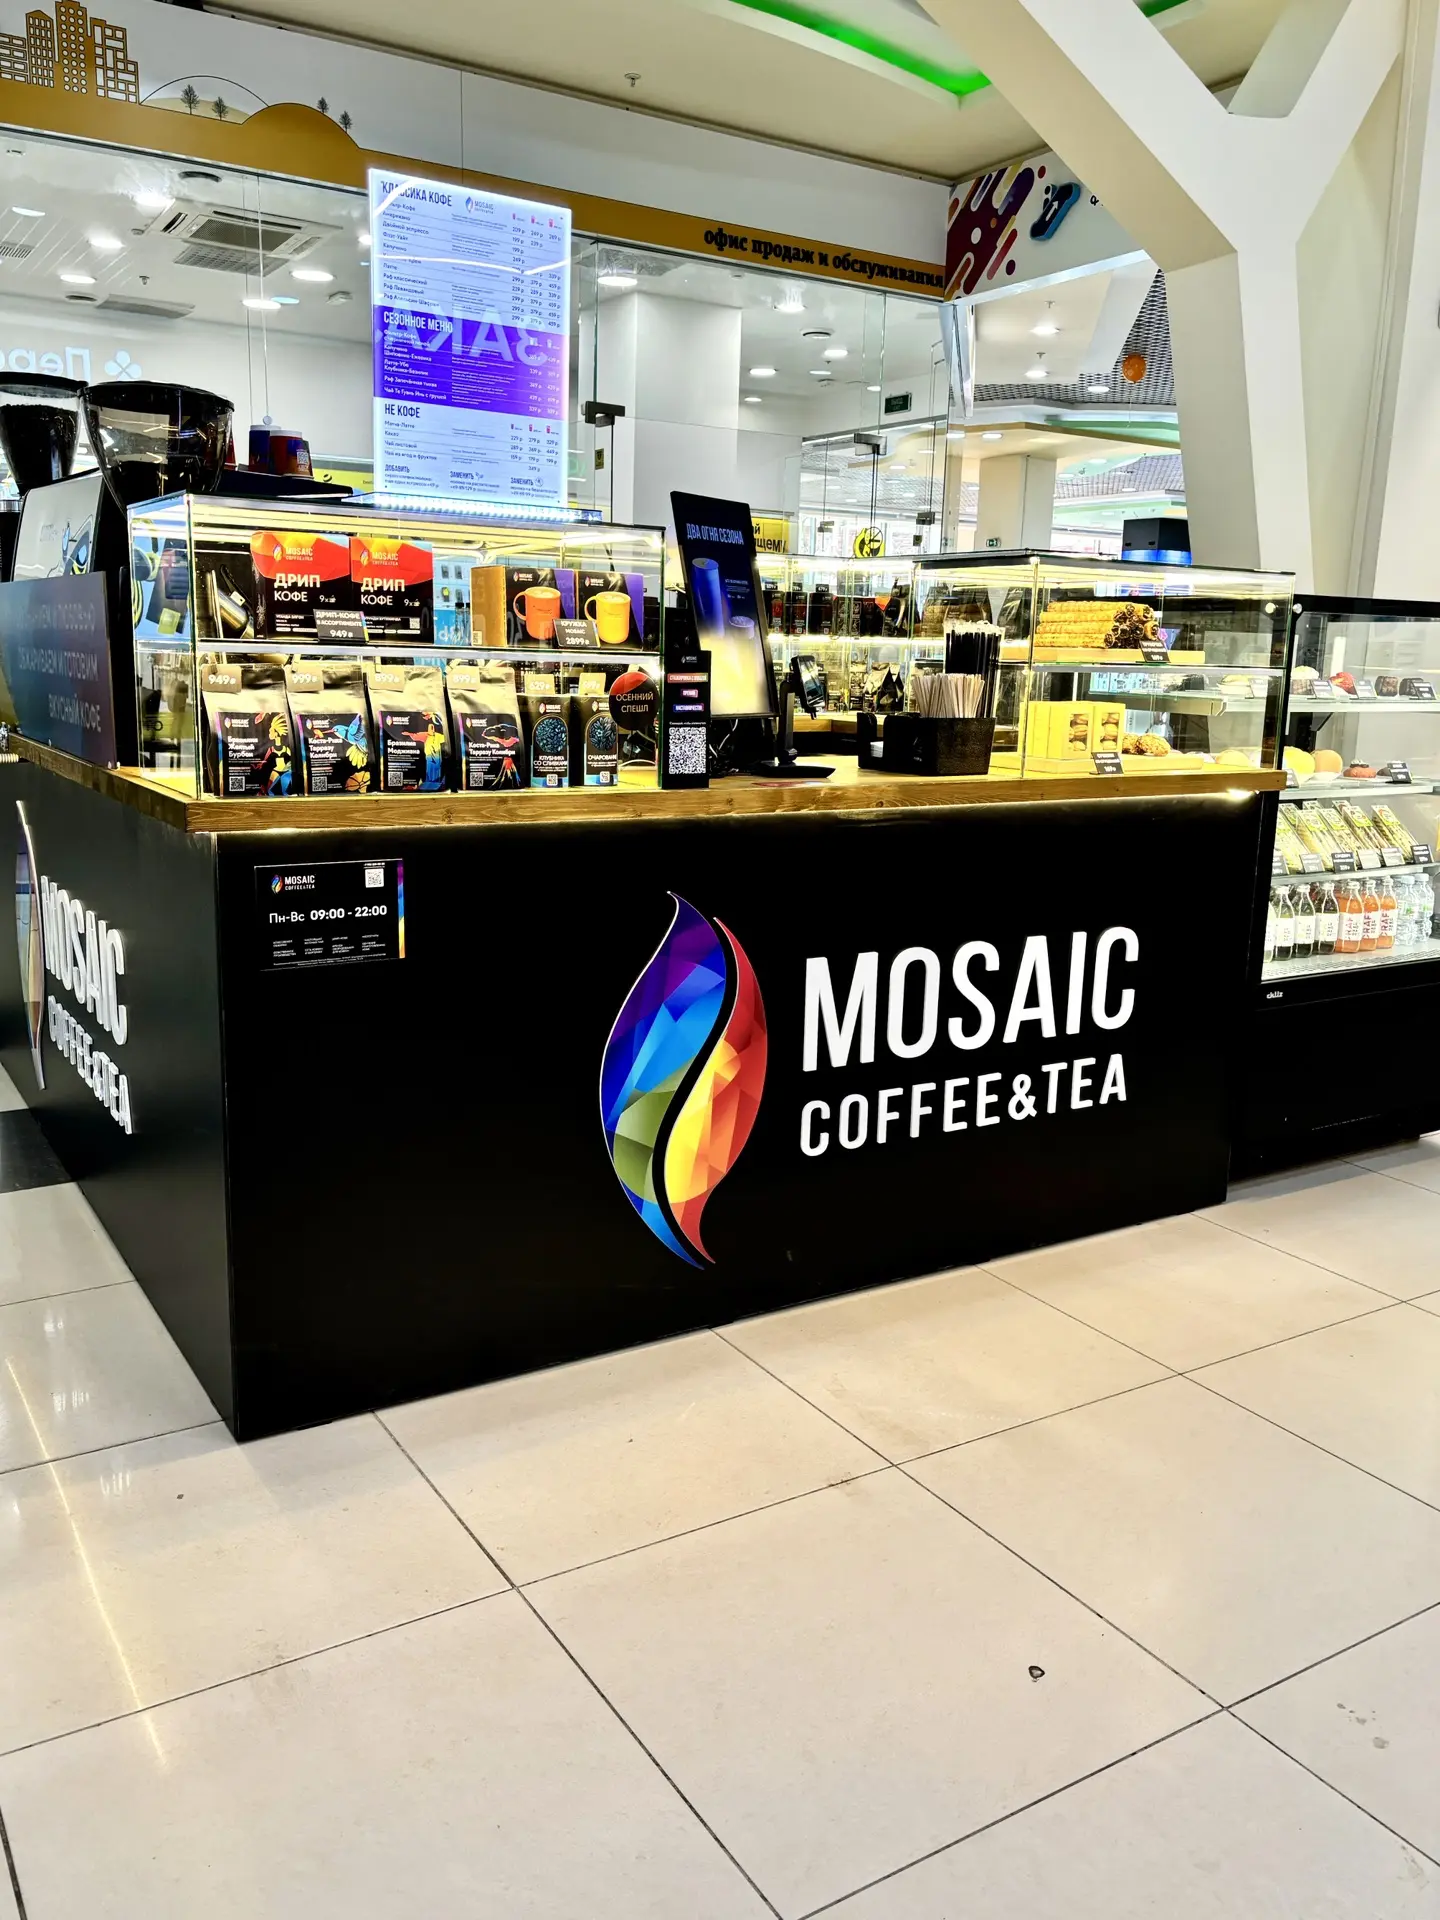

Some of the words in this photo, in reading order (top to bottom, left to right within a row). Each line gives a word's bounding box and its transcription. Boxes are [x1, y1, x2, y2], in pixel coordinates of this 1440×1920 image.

[382, 181, 427, 201] КЛСИКА
[429, 191, 452, 207] КОФЕ
[704, 227, 747, 251] офис
[751, 238, 814, 264] продаж
[819, 251, 828, 266] и
[833, 253, 943, 288] обслуживания
[384, 311, 426, 329] СЕЗОННОЕ
[428, 318, 453, 333] МЕНЮ
[385, 404, 395, 415] НЕ
[398, 405, 420, 418] КОФЕ
[450, 471, 474, 479] ЗАМЕНИТЬ
[686, 523, 701, 539] ДВА
[701, 525, 719, 541] ОГНЯ
[719, 528, 744, 545] СЕЗОНА
[286, 547, 313, 556] MOSAIC
[371, 551, 398, 560] MOSAIC
[274, 573, 320, 588] ДРИП
[361, 577, 405, 592] ДРИП
[274, 591, 308, 602] КОФЕ
[360, 594, 393, 606] КОФЕ
[316, 611, 360, 620] ДРИП-КОФЕ
[616, 692, 654, 701] ОСЕННИЙ
[621, 704, 649, 713] СПЕШЛ
[81, 701, 101, 733] КОФЕ
[284, 875, 315, 885] MOSAIC
[269, 912, 305, 924] Пн-Вс
[310, 908, 345, 921] 09:00
[354, 905, 387, 917] 22:00
[41, 875, 128, 1046] MOSAIC
[802, 925, 1140, 1073] MOSAIC
[48, 995, 133, 1135] COFFEE&TEA
[800, 1053, 1128, 1157] COFFEE&TEA
